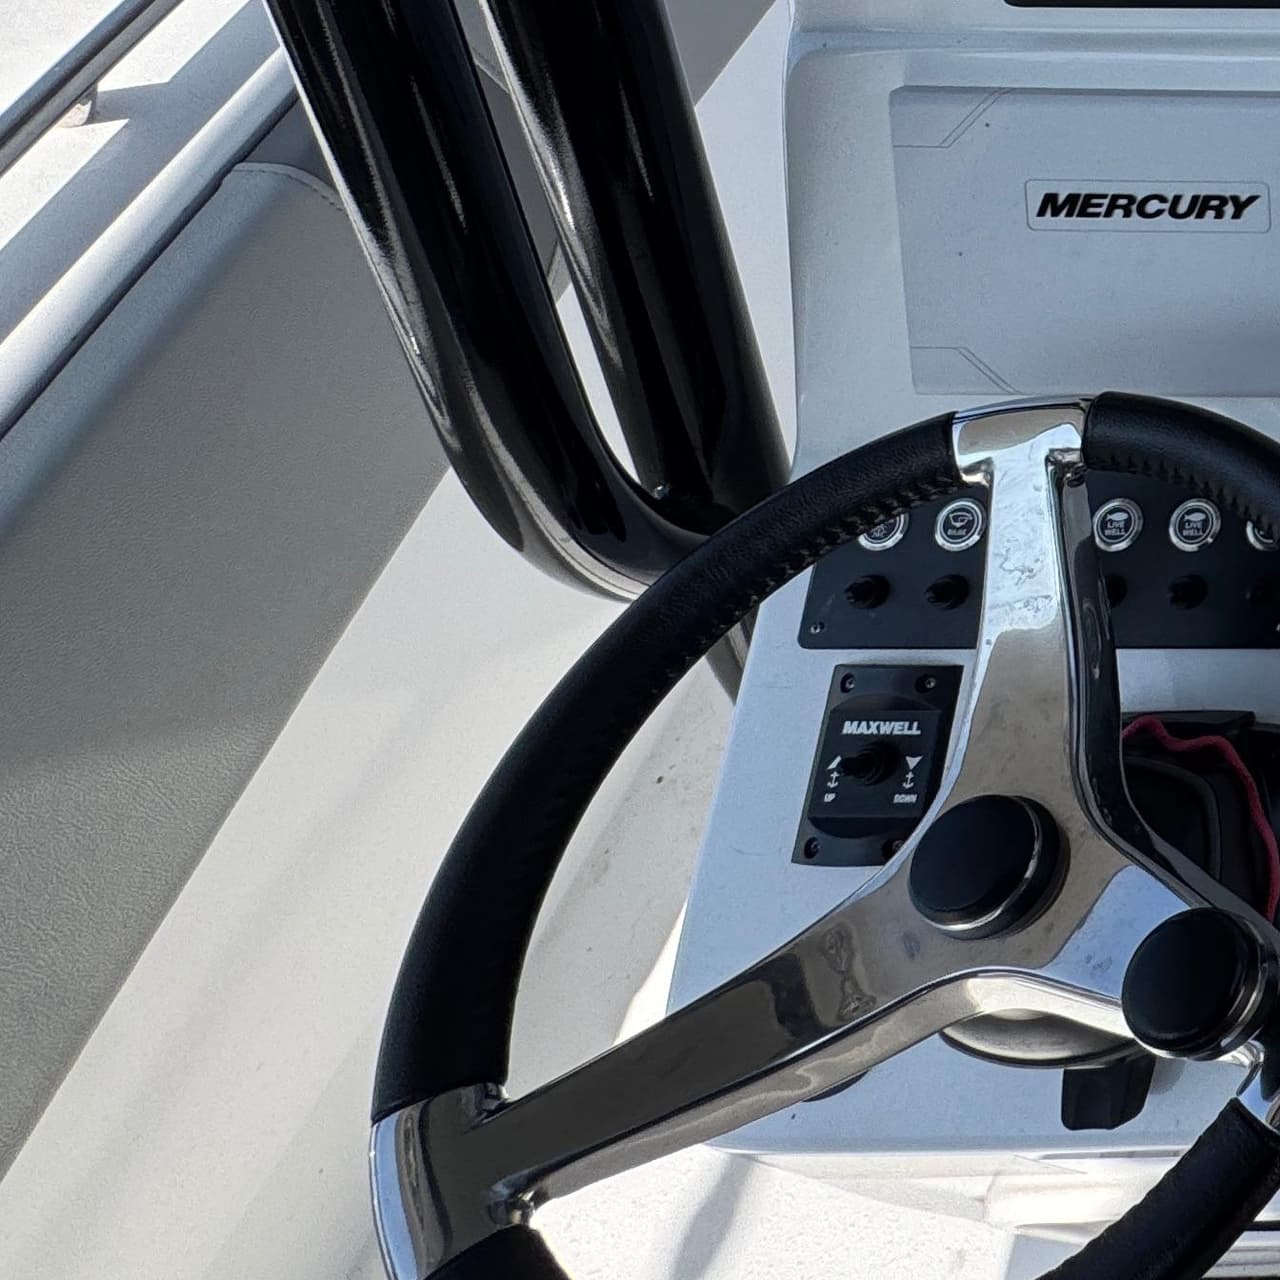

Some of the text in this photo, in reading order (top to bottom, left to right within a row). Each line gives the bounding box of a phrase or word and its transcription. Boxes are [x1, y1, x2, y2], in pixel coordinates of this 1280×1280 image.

[1036, 192, 1261, 221] MERCURY
[1107, 521, 1125, 529] LIVE
[1184, 521, 1203, 529] LIVE
[1104, 528, 1126, 536] WELL
[1182, 528, 1204, 536] WELL
[841, 720, 922, 735] MAXWELL
[823, 792, 836, 802] UP
[893, 793, 918, 804] DOWN
